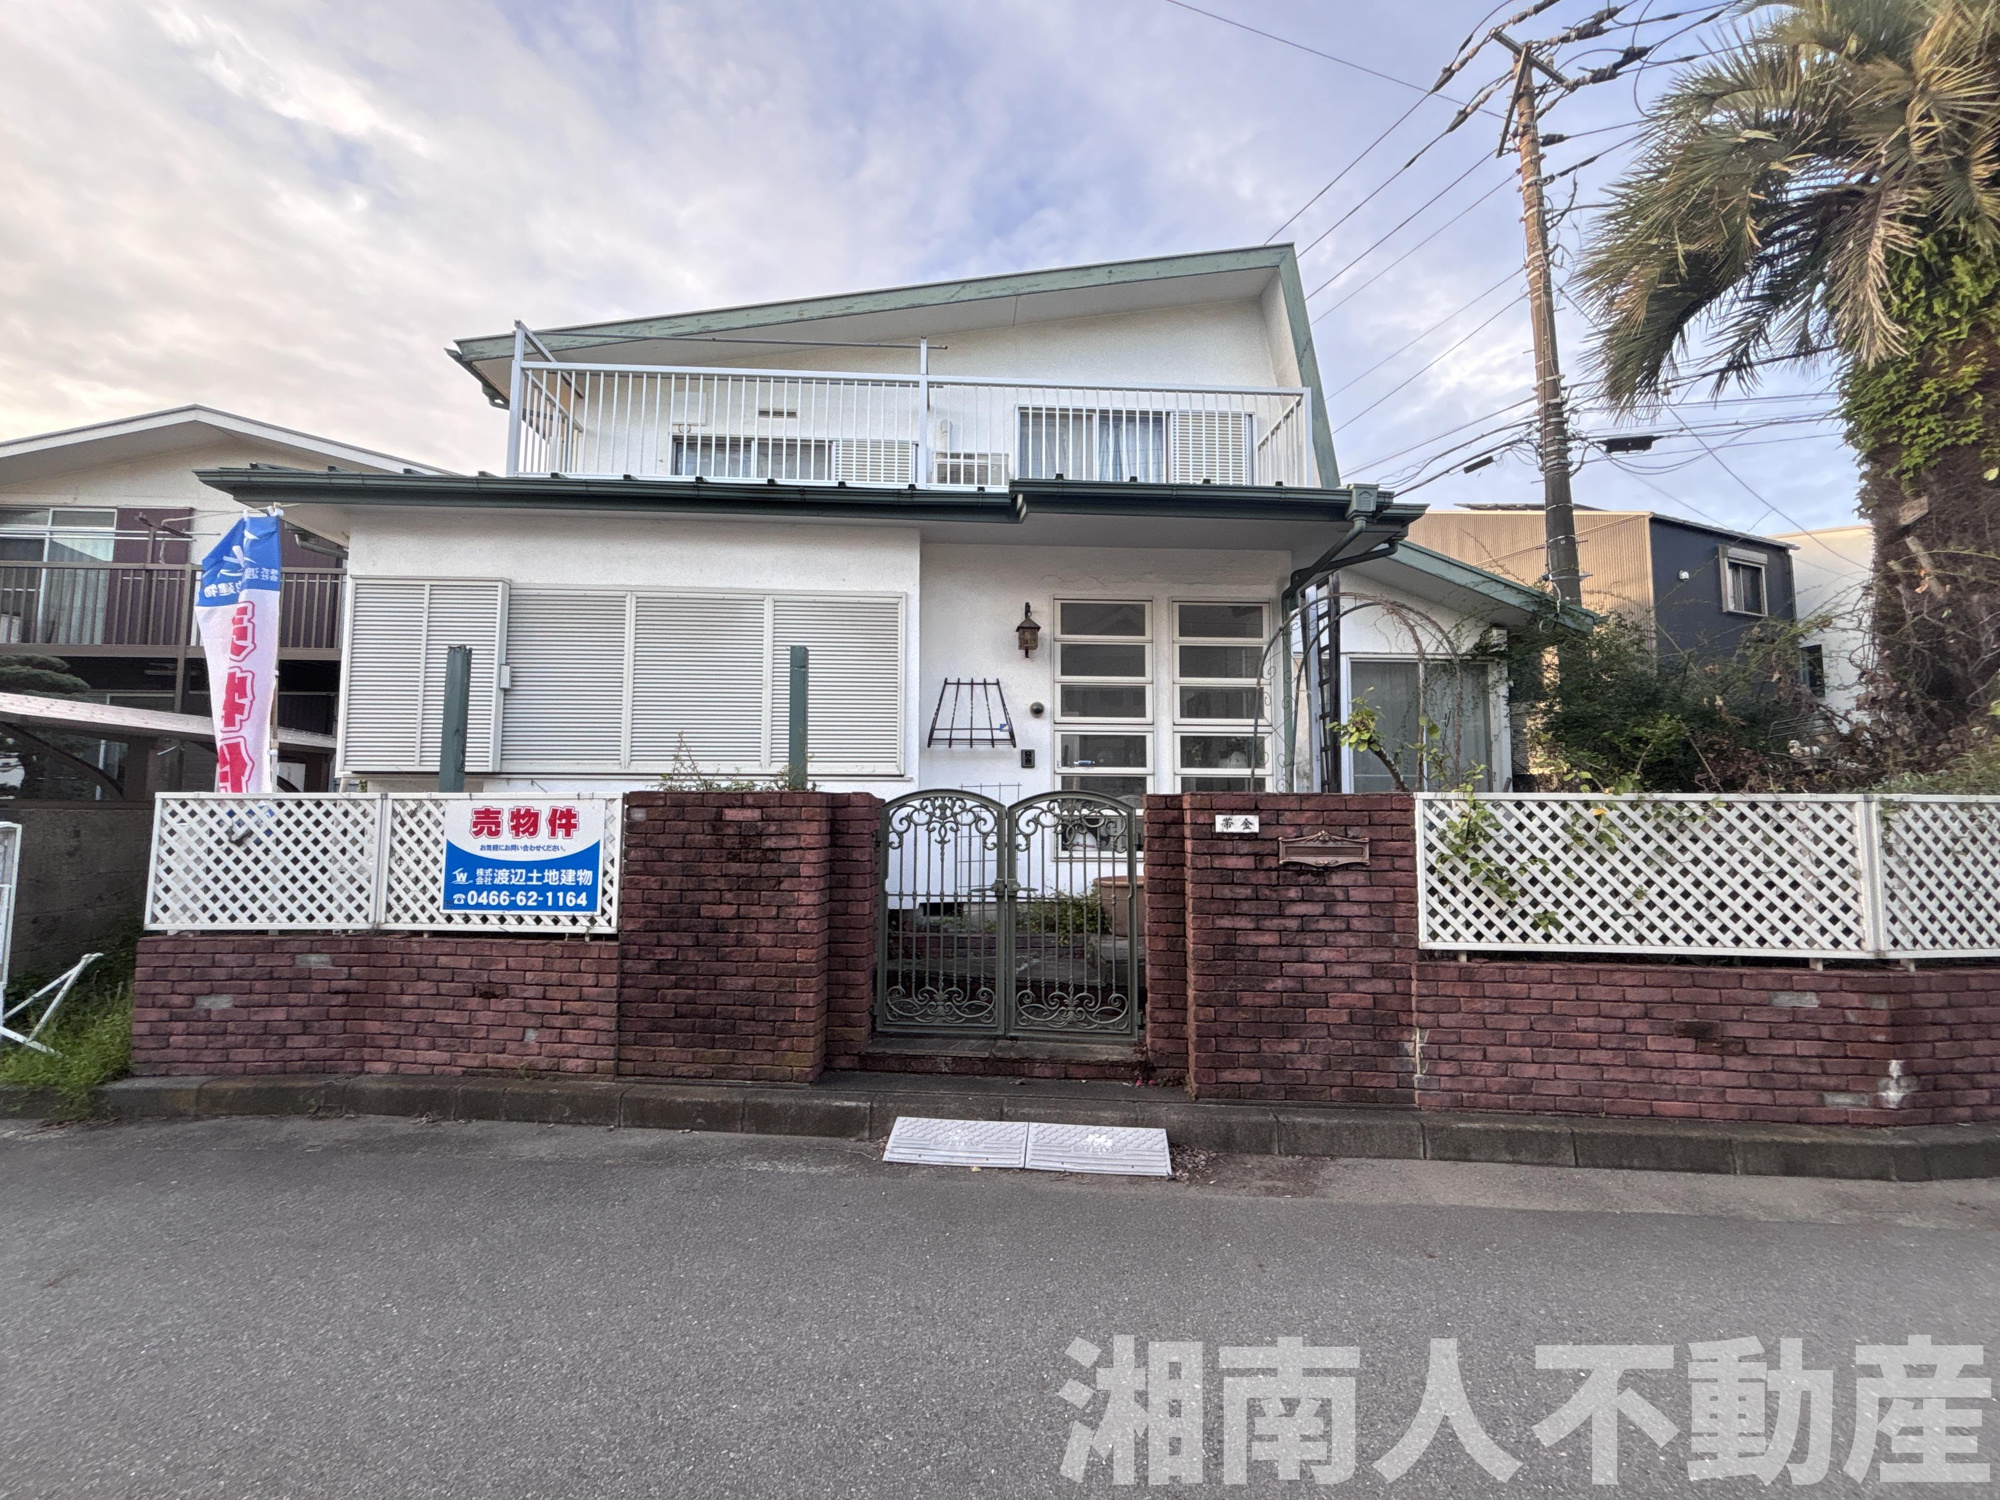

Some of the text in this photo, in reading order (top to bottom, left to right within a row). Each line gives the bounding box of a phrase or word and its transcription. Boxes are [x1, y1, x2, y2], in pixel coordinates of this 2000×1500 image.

[471, 807, 579, 838] 売物件
[476, 867, 493, 876] 株式
[493, 868, 593, 886] 渡辺土地建物
[475, 876, 493, 885] 会社
[467, 890, 587, 907] 0466-62-1164
